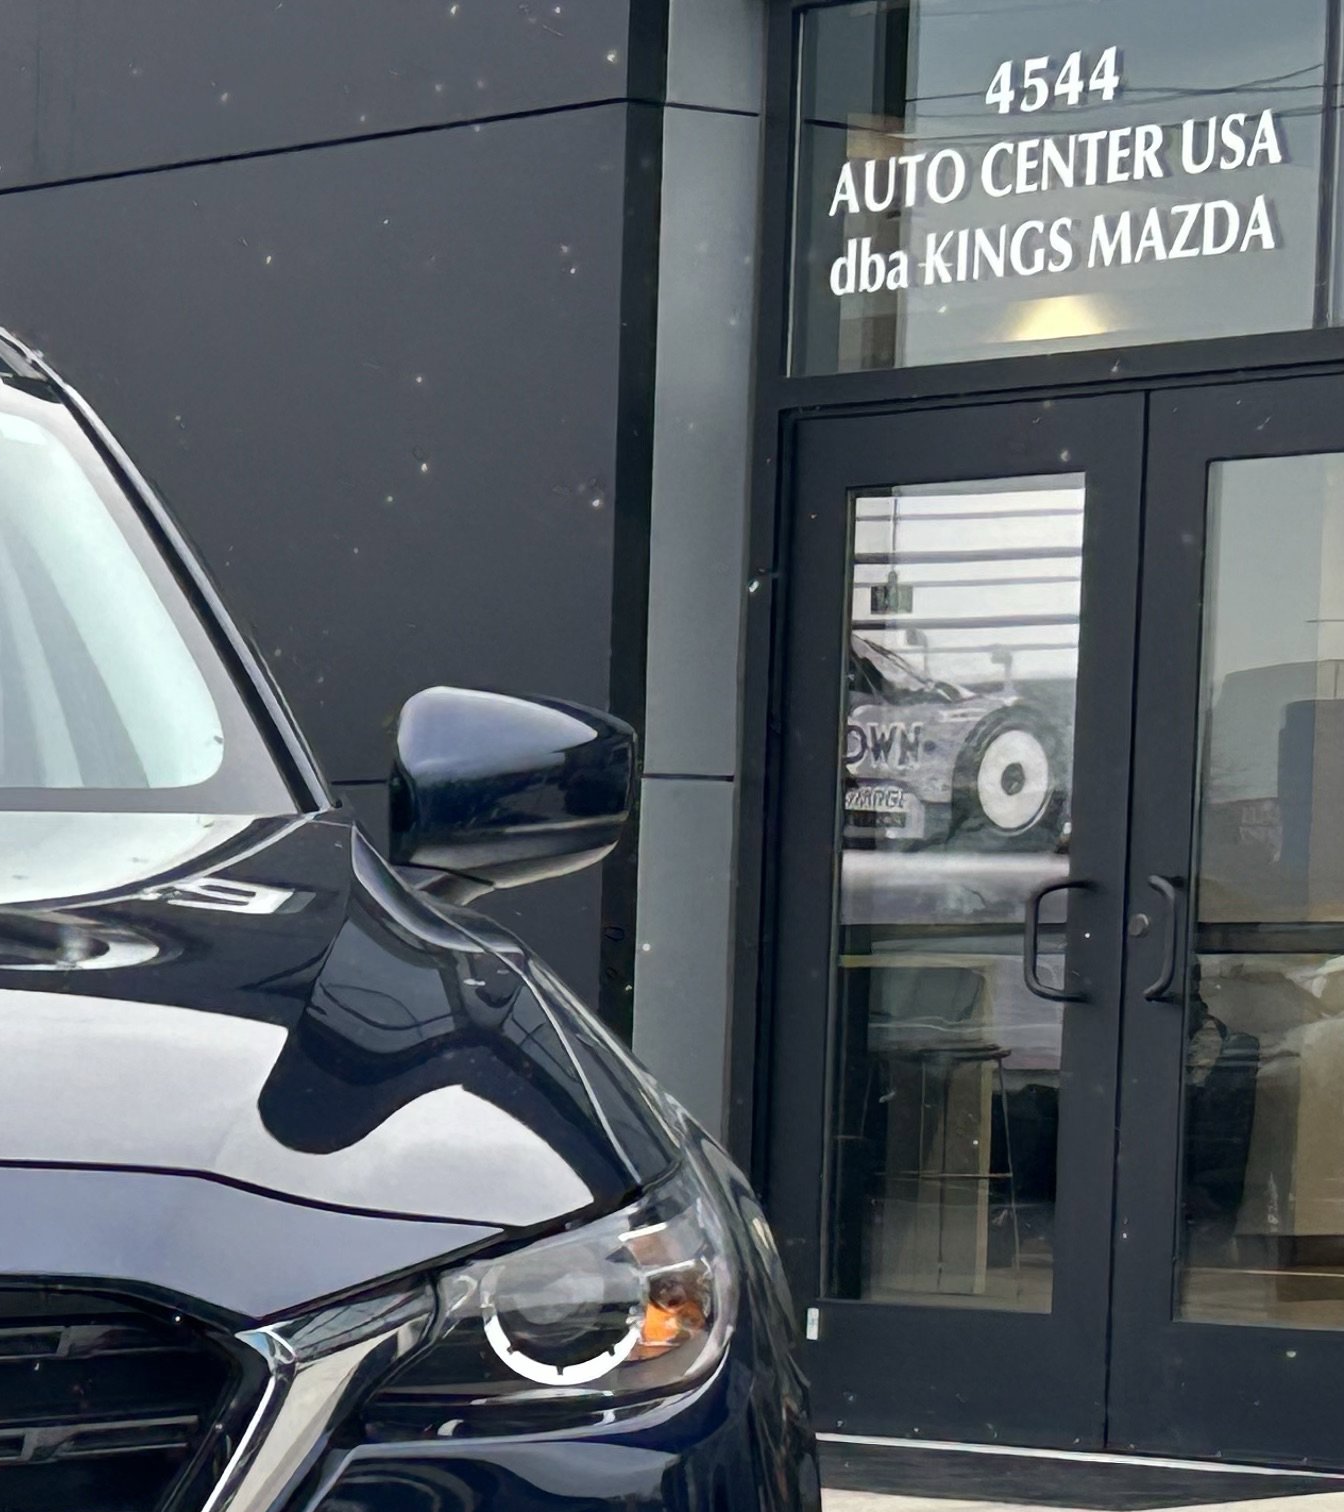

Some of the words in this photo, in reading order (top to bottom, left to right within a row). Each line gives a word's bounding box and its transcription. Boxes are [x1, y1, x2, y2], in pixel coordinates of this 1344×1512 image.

[985, 45, 1121, 114] 4544
[828, 148, 967, 217] AUTO
[980, 124, 1165, 198] CENTER
[1181, 108, 1283, 175] USA
[830, 237, 910, 296] dba
[921, 216, 1073, 286] KINGS
[1087, 194, 1276, 269] MAZDA
